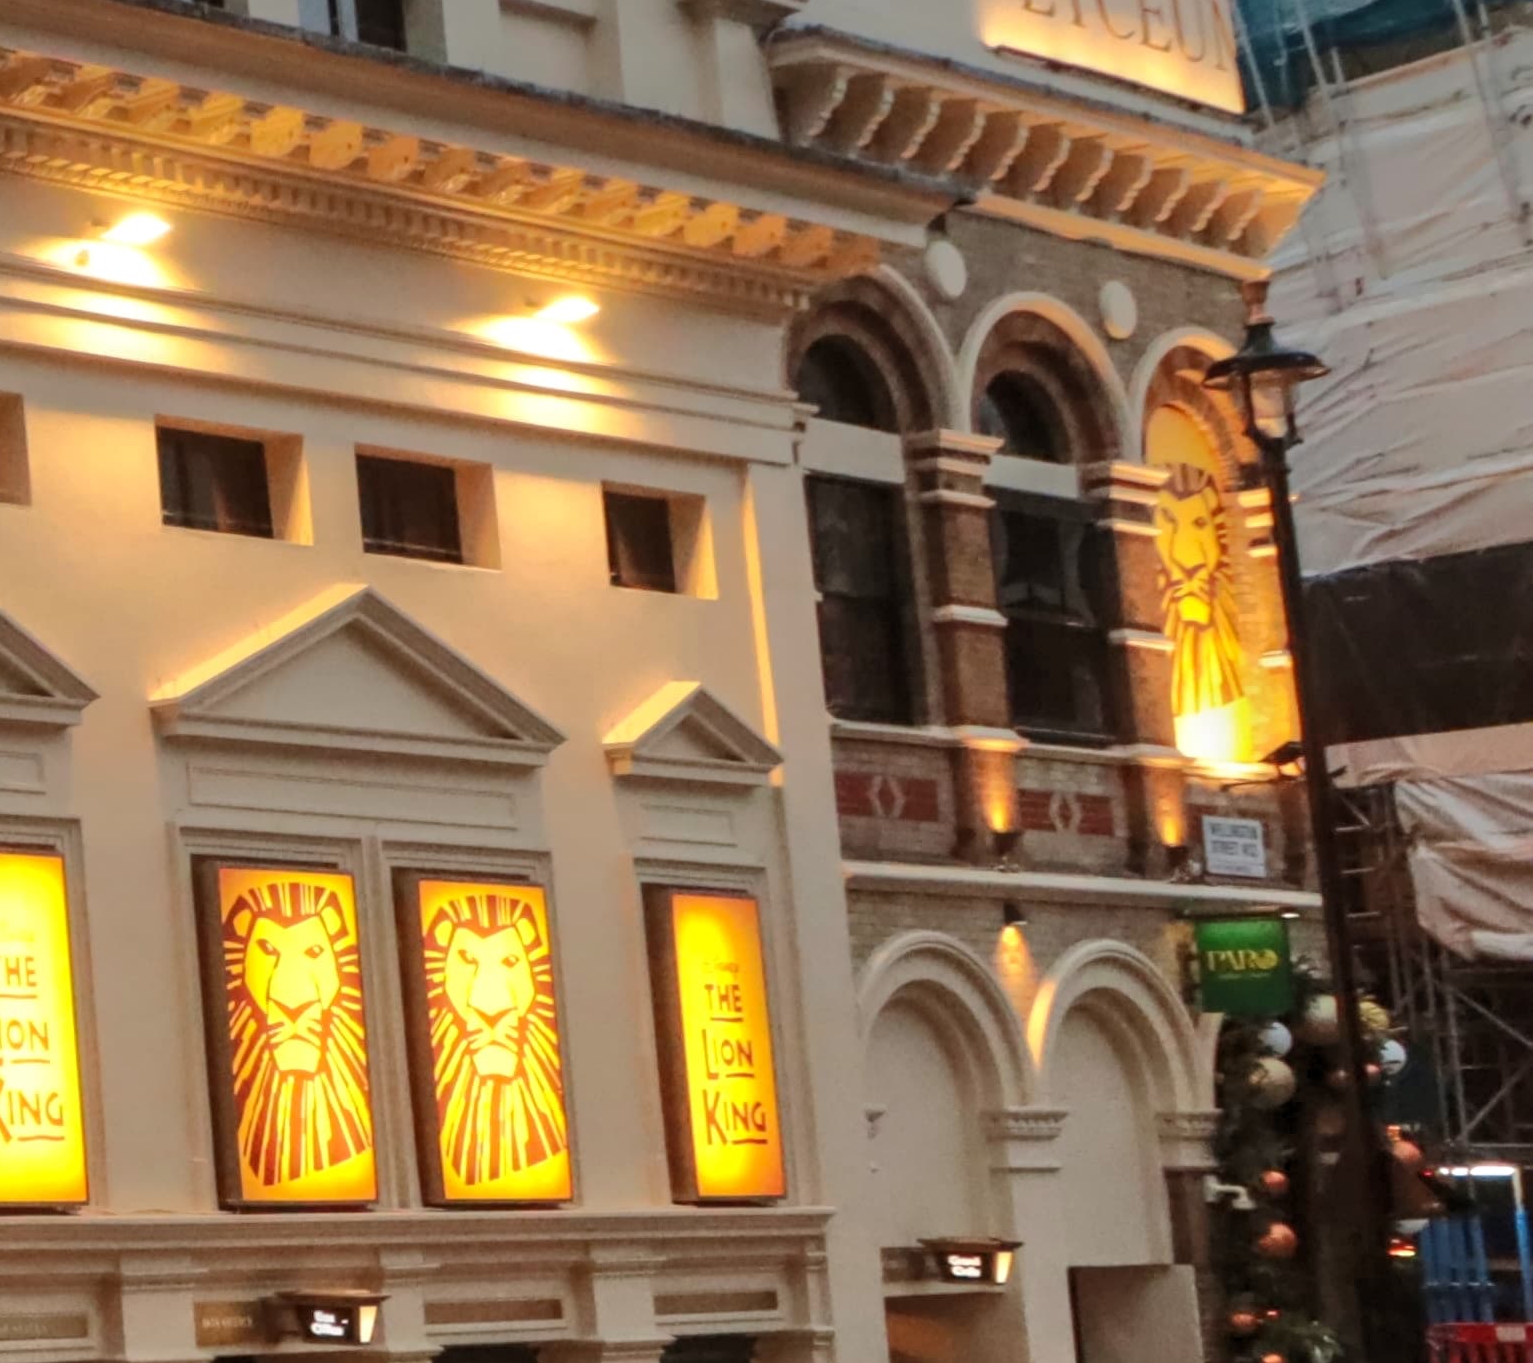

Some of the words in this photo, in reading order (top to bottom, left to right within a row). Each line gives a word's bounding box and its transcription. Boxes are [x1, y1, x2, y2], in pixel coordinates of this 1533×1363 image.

[704, 984, 743, 1013] THE
[702, 1028, 754, 1080] LION
[703, 1089, 767, 1145] KING
